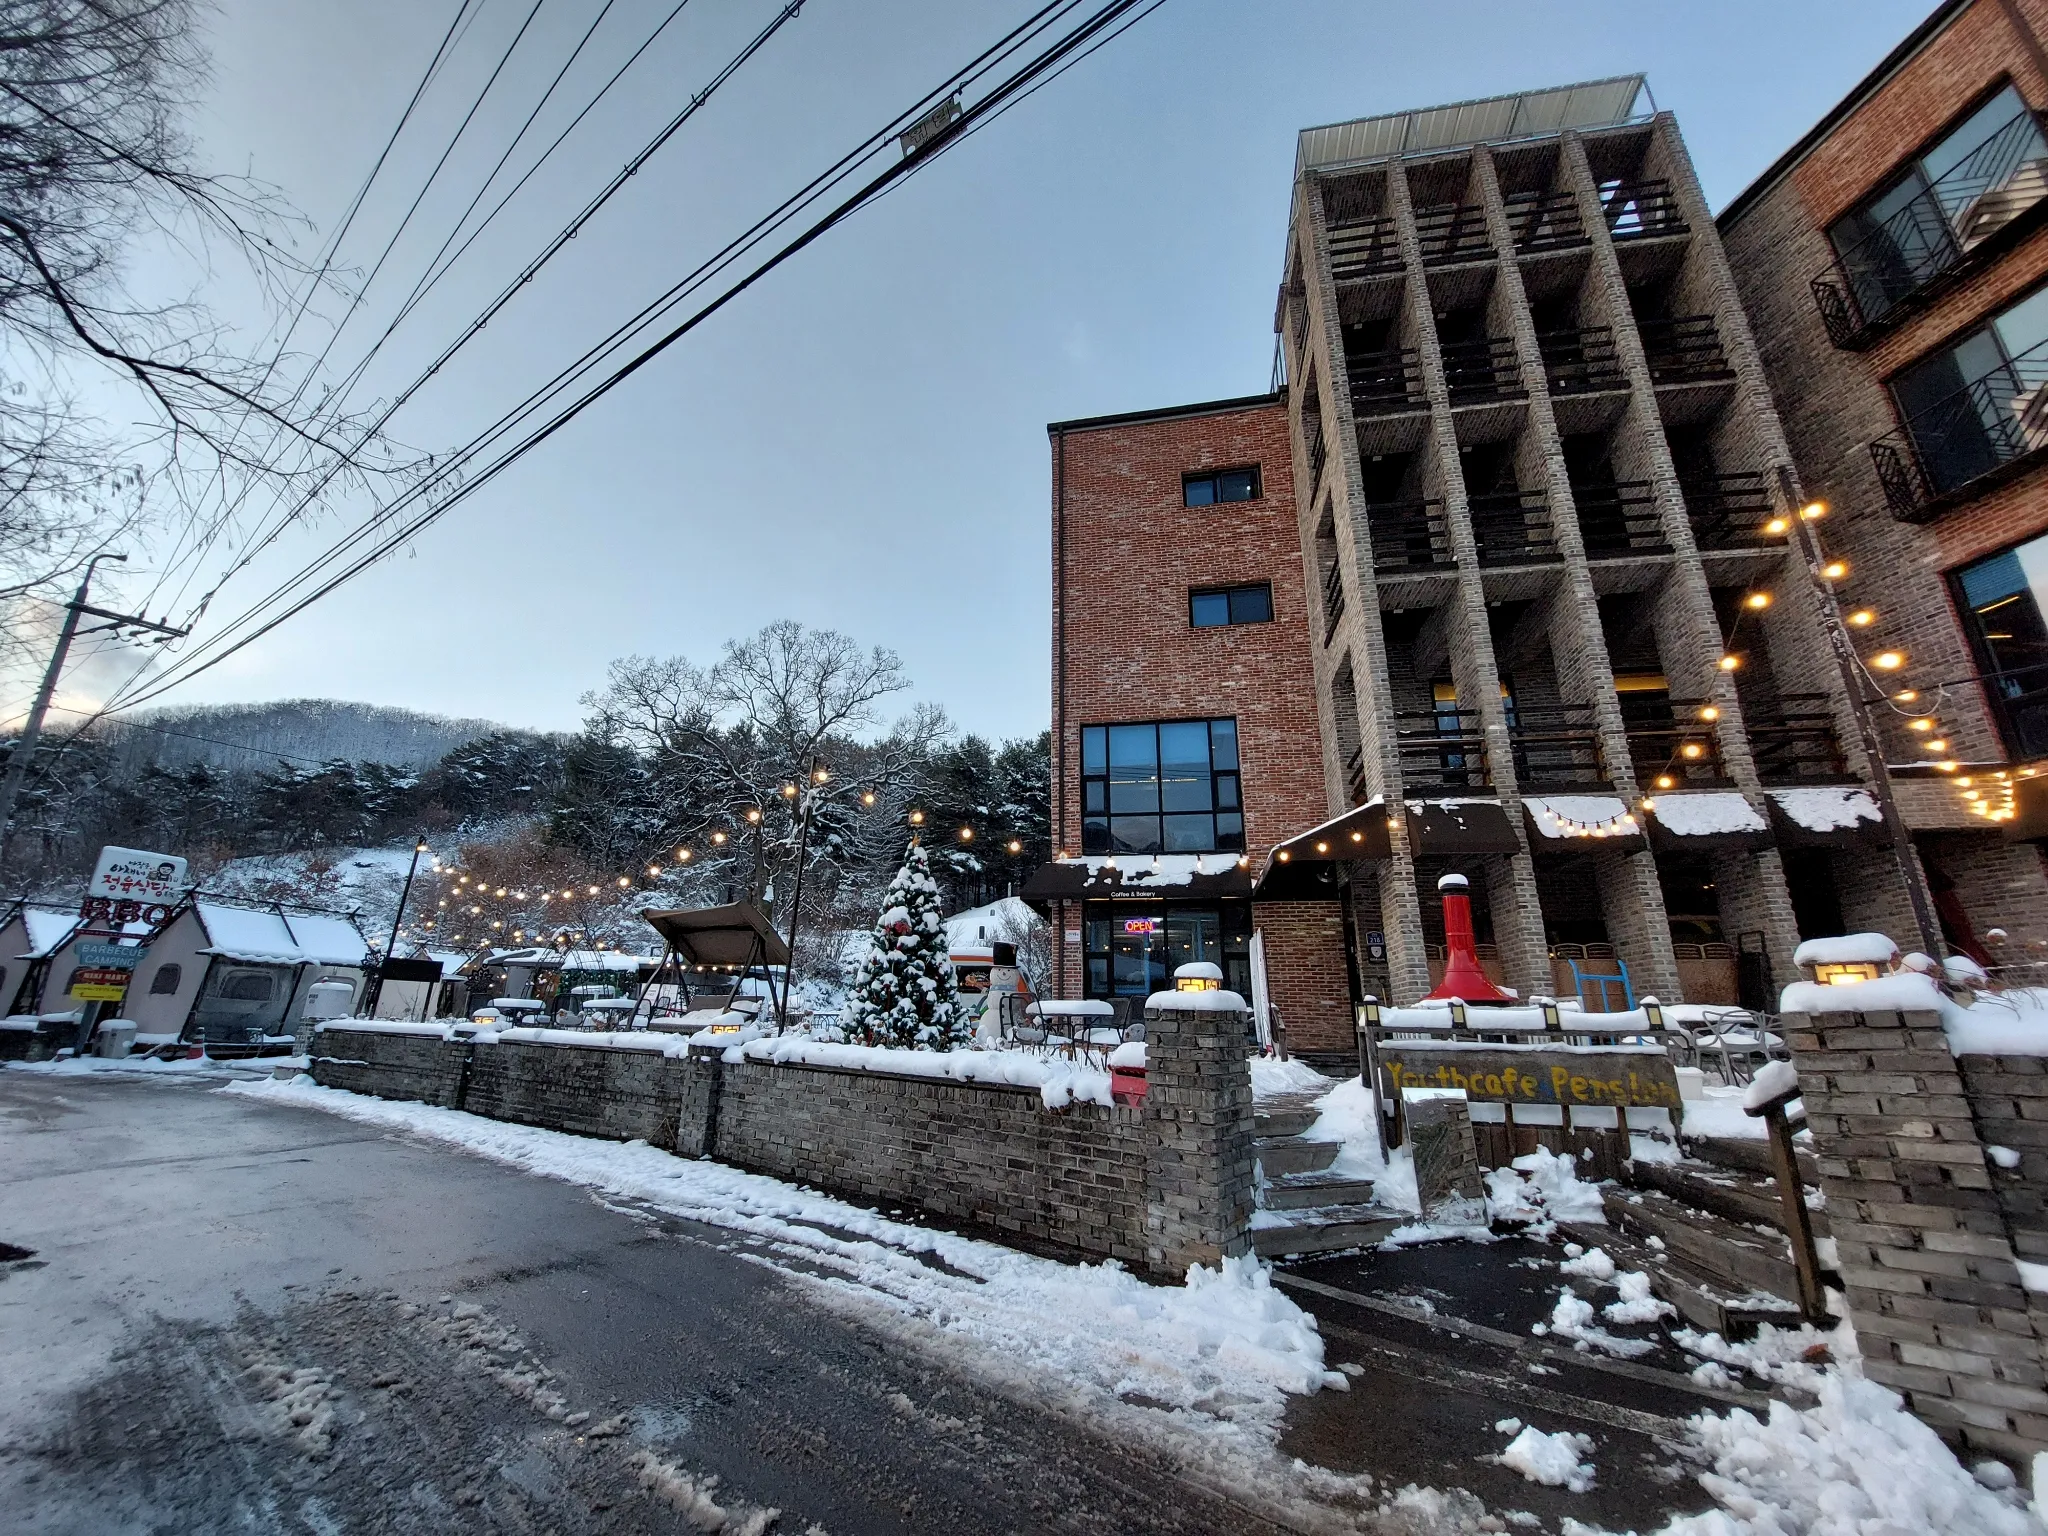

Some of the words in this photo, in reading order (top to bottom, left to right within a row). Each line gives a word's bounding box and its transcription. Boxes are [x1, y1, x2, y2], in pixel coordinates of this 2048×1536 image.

[101, 874, 170, 897] 정육식당
[80, 897, 173, 927] BBQ
[1126, 921, 1153, 931] OPEN
[82, 944, 144, 957] BARBECUE
[84, 955, 135, 967] CAMPING
[1385, 1062, 1538, 1097] Youthcafe
